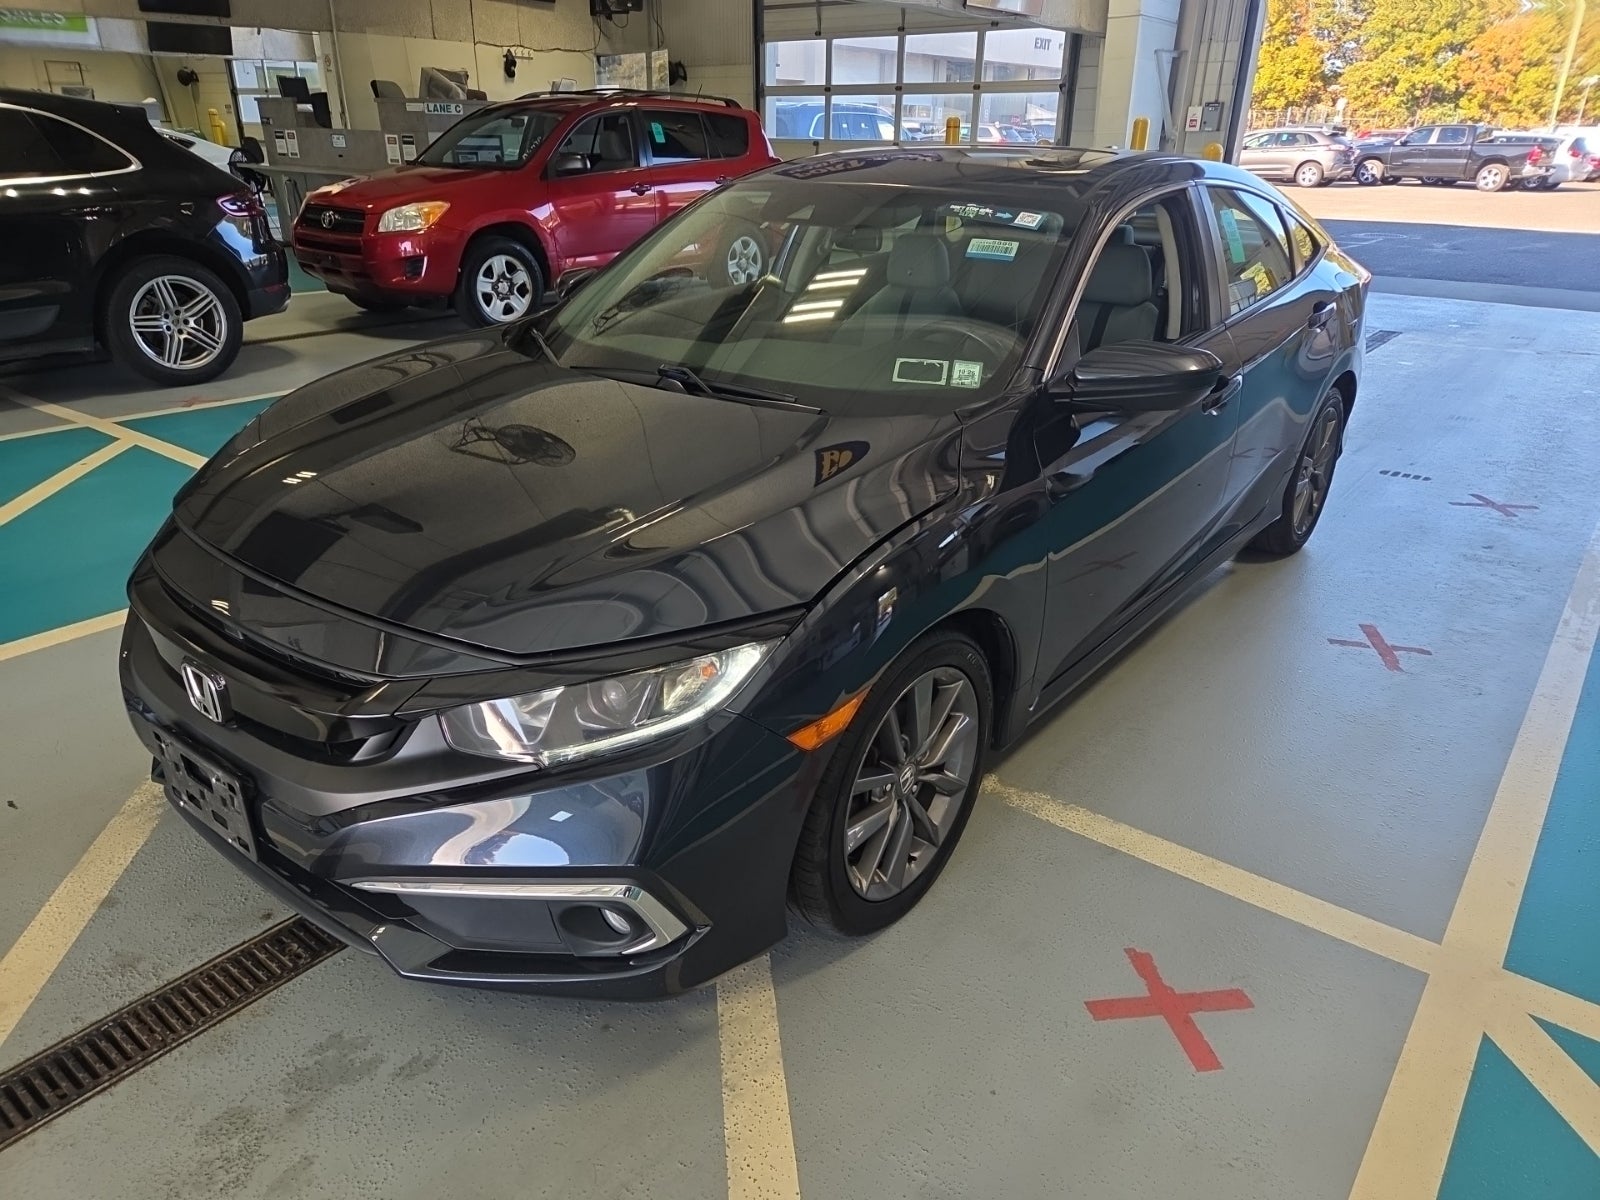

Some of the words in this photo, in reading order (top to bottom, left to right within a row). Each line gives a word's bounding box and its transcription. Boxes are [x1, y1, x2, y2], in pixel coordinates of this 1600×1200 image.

[1034, 37, 1052, 50] EXIT
[426, 103, 452, 113] LANE
[454, 104, 461, 113] C
